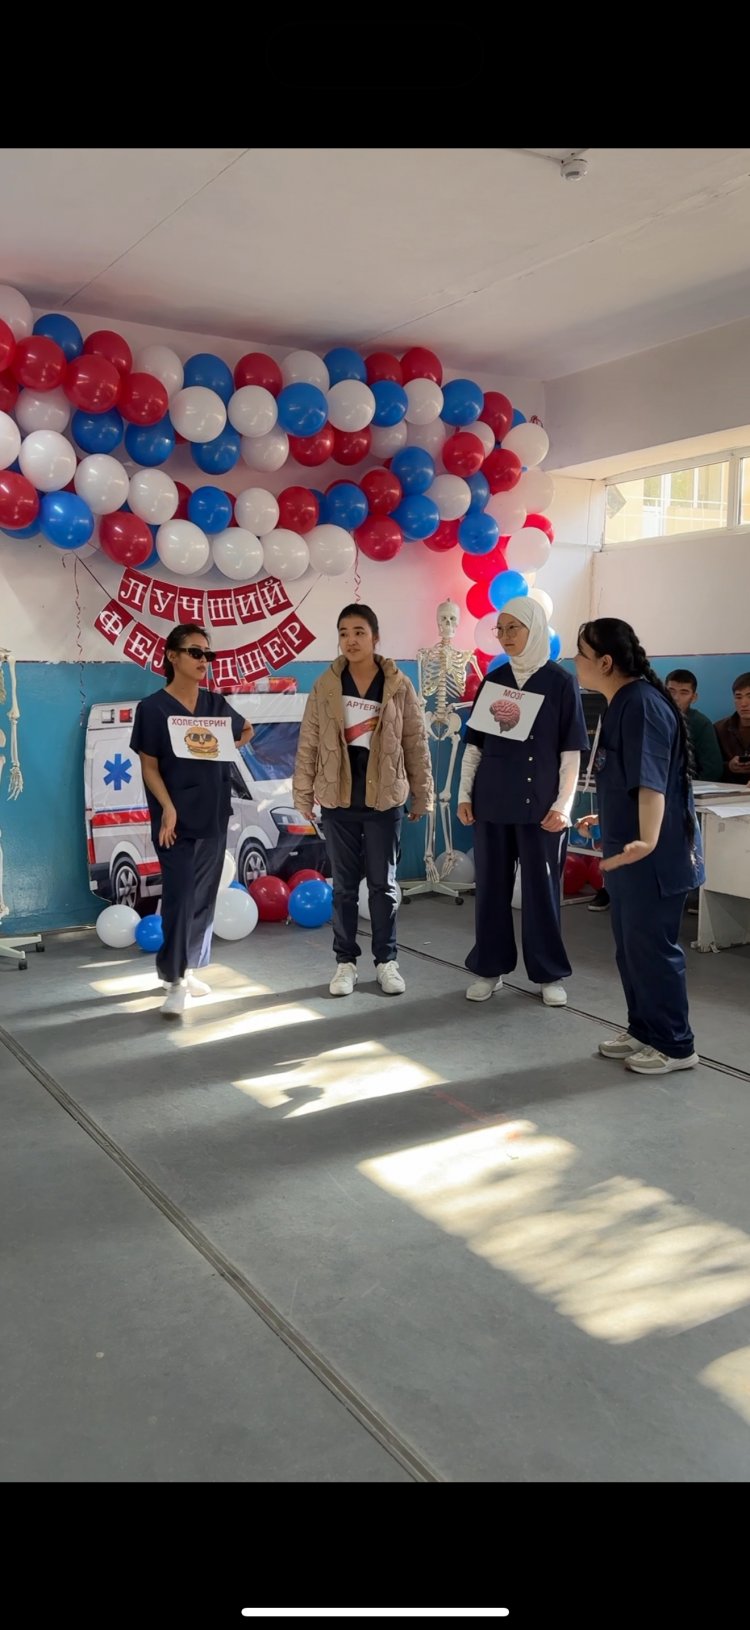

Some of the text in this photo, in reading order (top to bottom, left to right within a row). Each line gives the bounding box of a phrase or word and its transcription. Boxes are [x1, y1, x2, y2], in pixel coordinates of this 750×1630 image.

[120, 577, 288, 621] ЛУЧШИЙ
[99, 610, 303, 686] ФЕДШЕР
[503, 689, 526, 701] МОЗГ
[171, 718, 227, 727] ХОЛЕСТЕРИН
